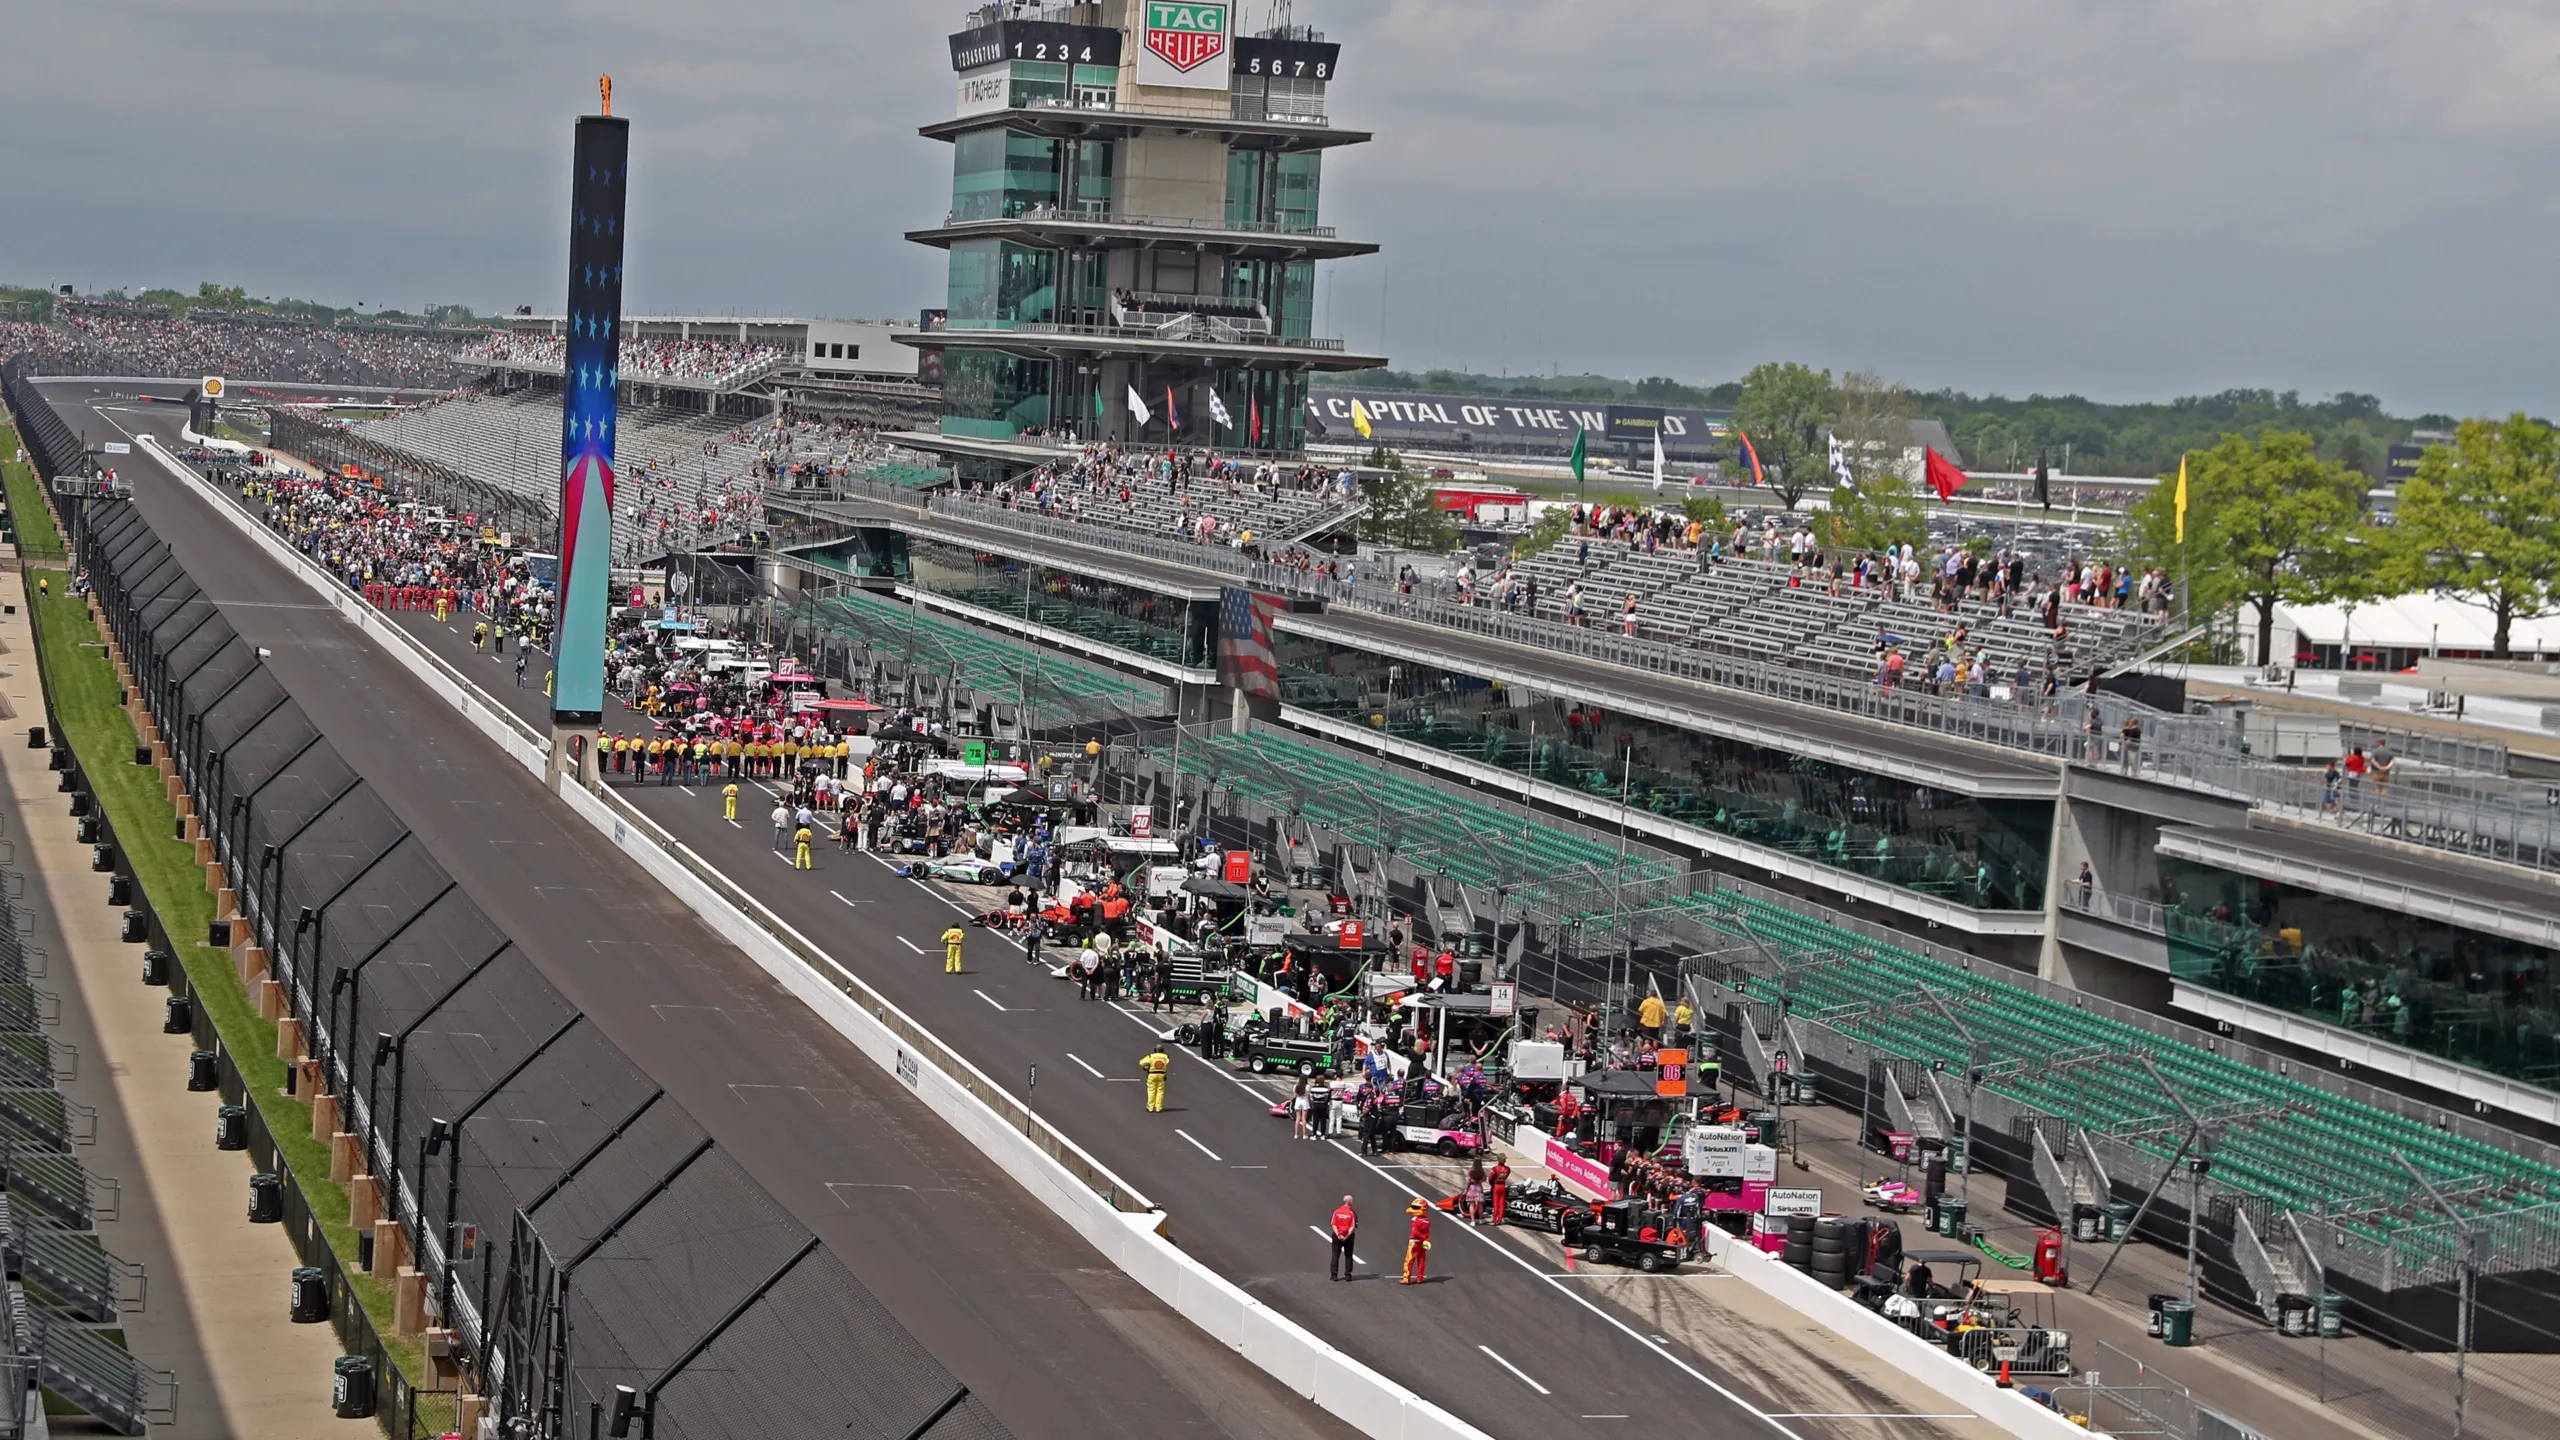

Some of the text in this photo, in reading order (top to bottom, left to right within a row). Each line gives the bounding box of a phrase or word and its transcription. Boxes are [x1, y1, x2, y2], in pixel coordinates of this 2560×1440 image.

[1154, 6, 1217, 30] TAG
[1014, 41, 1092, 63] 1 2 3 4
[1151, 32, 1219, 66] HEUER
[1250, 58, 1326, 78] 5 6 7 8
[1327, 398, 1458, 425] CAPITAL
[1460, 405, 1501, 426] OF
[1504, 407, 1568, 430] THE
[1622, 418, 1660, 427] GAINBRIDGE
[781, 662, 793, 675] 27
[1134, 817, 1149, 828] 30
[1234, 868, 1241, 876] 11
[1345, 923, 1357, 934] 55
[1498, 988, 1508, 999] 14
[1664, 1064, 1680, 1080] 06
[1698, 1132, 1743, 1141] AutoNation
[1772, 1191, 1818, 1201] AutoNation
